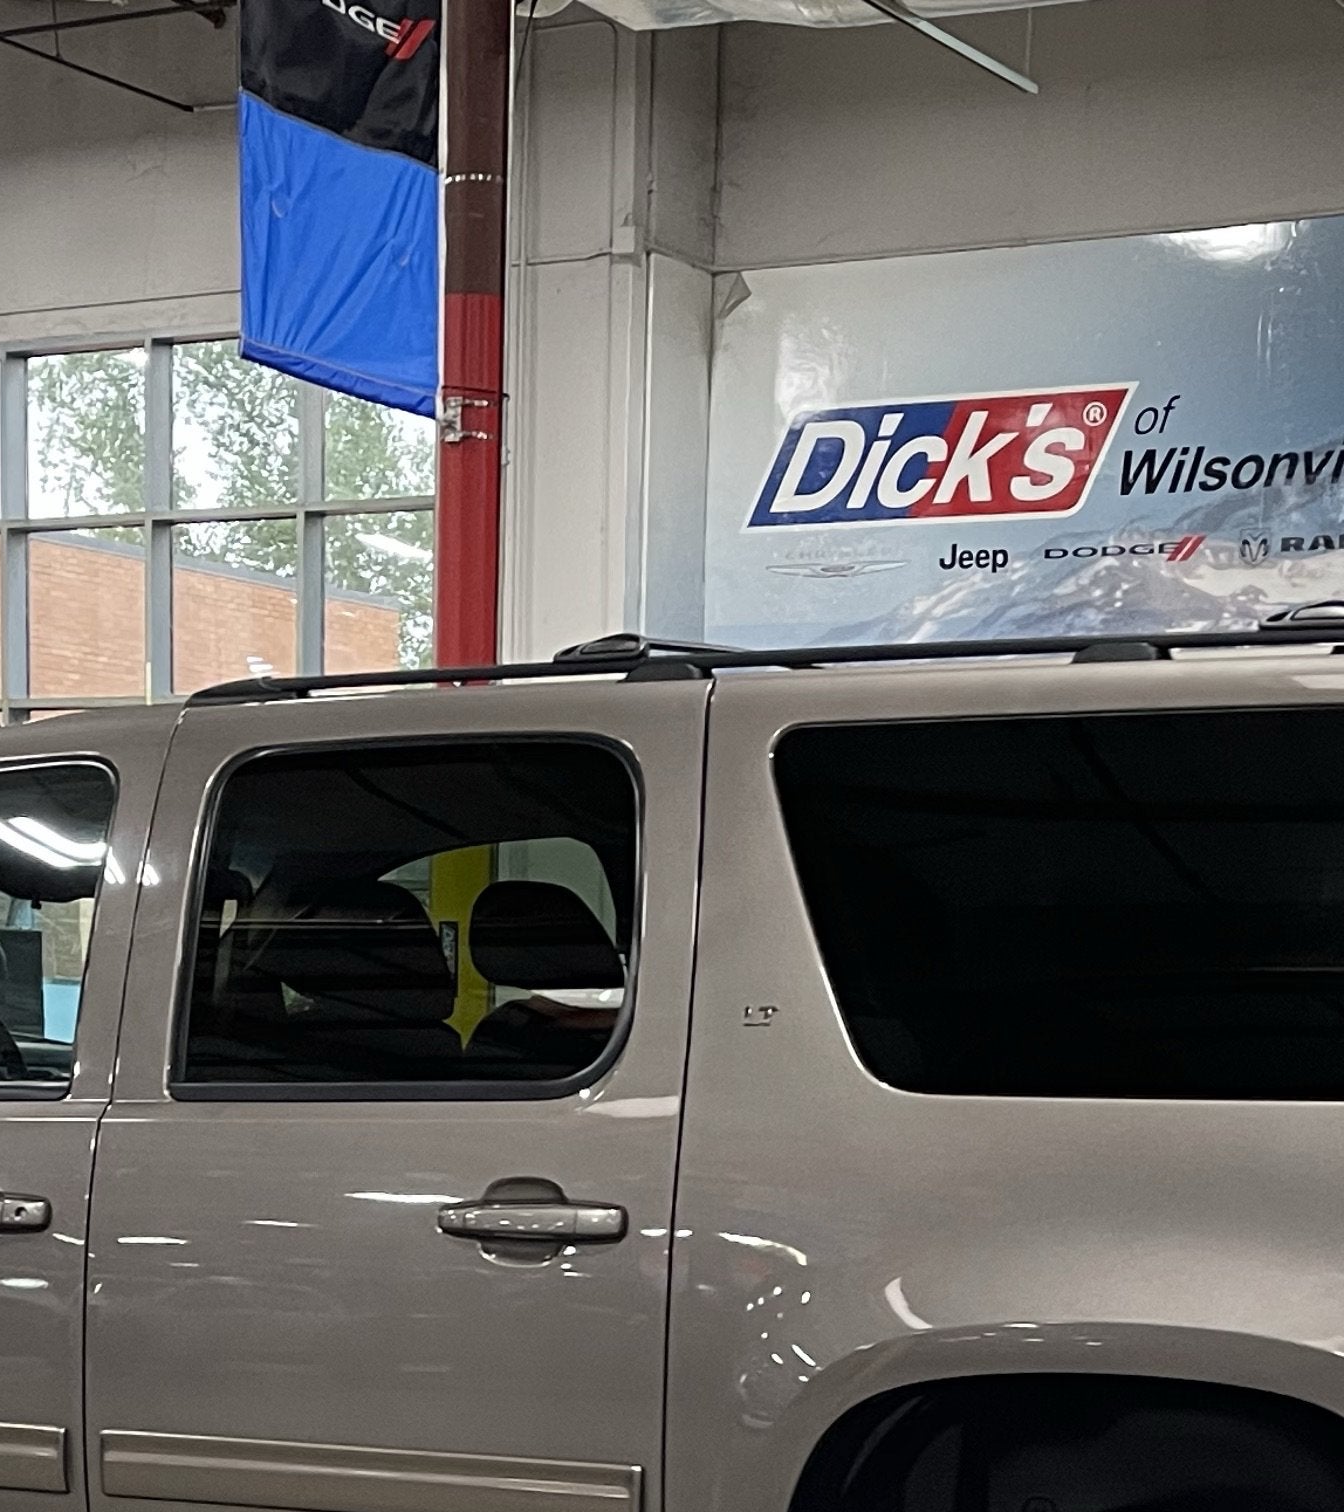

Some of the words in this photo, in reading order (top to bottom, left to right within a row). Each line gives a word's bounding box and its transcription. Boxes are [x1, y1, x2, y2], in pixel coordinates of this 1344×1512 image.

[1134, 395, 1181, 435] of
[939, 543, 1009, 573] Jeep
[1043, 541, 1182, 560] DODGE
